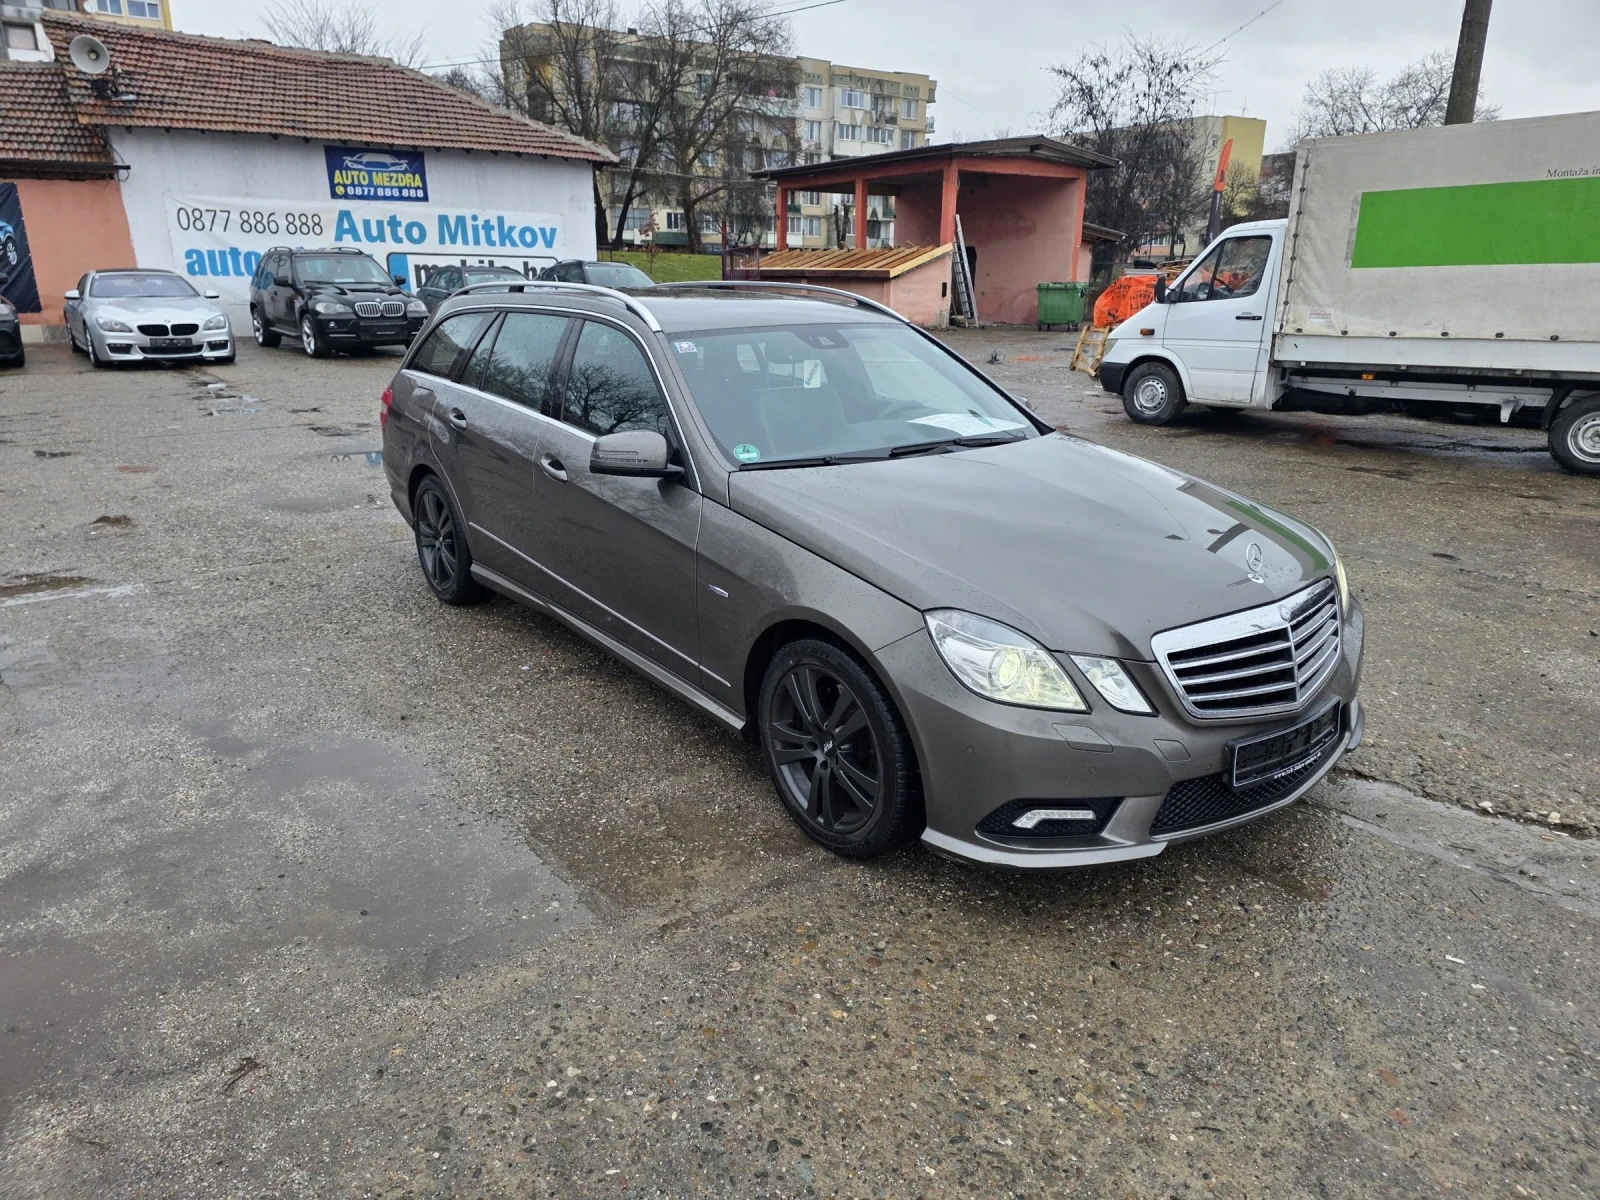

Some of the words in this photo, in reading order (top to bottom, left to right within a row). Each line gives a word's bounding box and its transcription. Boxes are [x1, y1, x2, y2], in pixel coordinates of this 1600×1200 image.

[334, 169, 369, 186] AUTO
[372, 171, 423, 188] MEZDRA
[1546, 166, 1589, 178] Montaža
[346, 186, 375, 196] 0877
[376, 187, 400, 197] 886
[401, 188, 424, 198] 888
[176, 207, 231, 232] 0877
[239, 210, 280, 235] 886
[285, 212, 324, 236] 888
[333, 209, 427, 245] Auto
[437, 214, 558, 249] Mitkov
